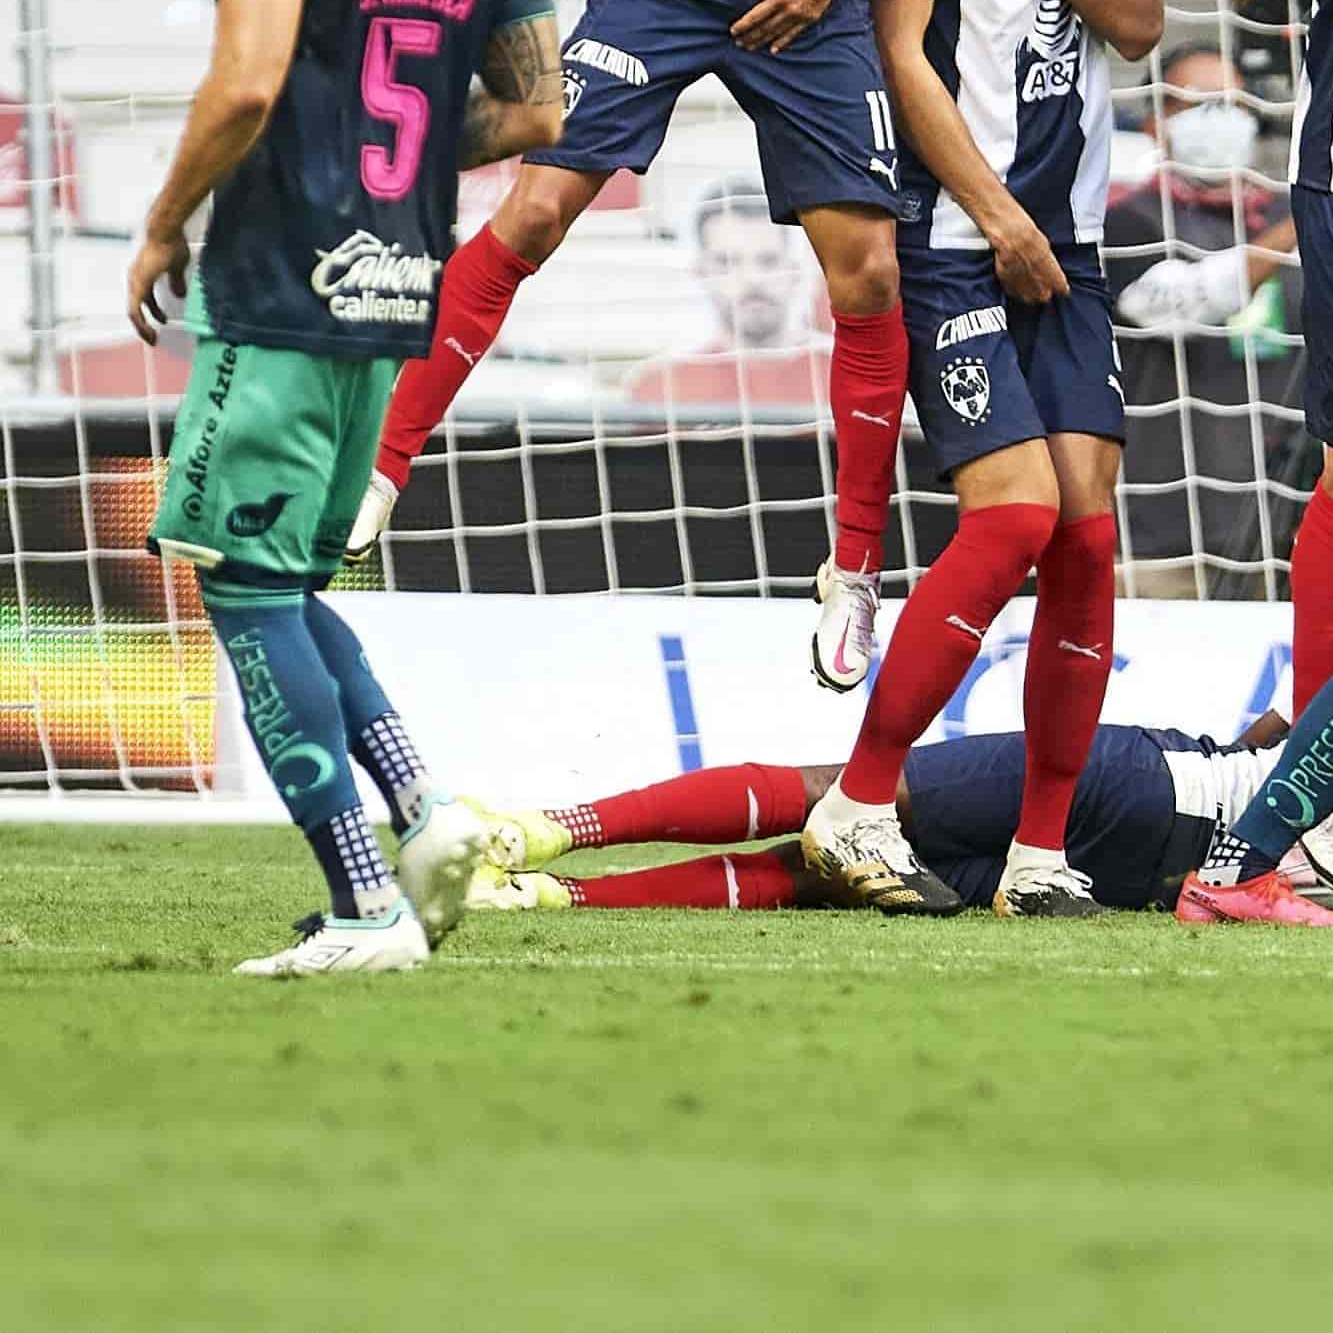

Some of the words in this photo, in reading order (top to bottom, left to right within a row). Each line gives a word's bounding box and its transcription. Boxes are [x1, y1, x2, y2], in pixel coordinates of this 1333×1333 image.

[359, 16, 442, 202] 5
[866, 89, 897, 151] 11
[186, 417, 218, 493] Afore
